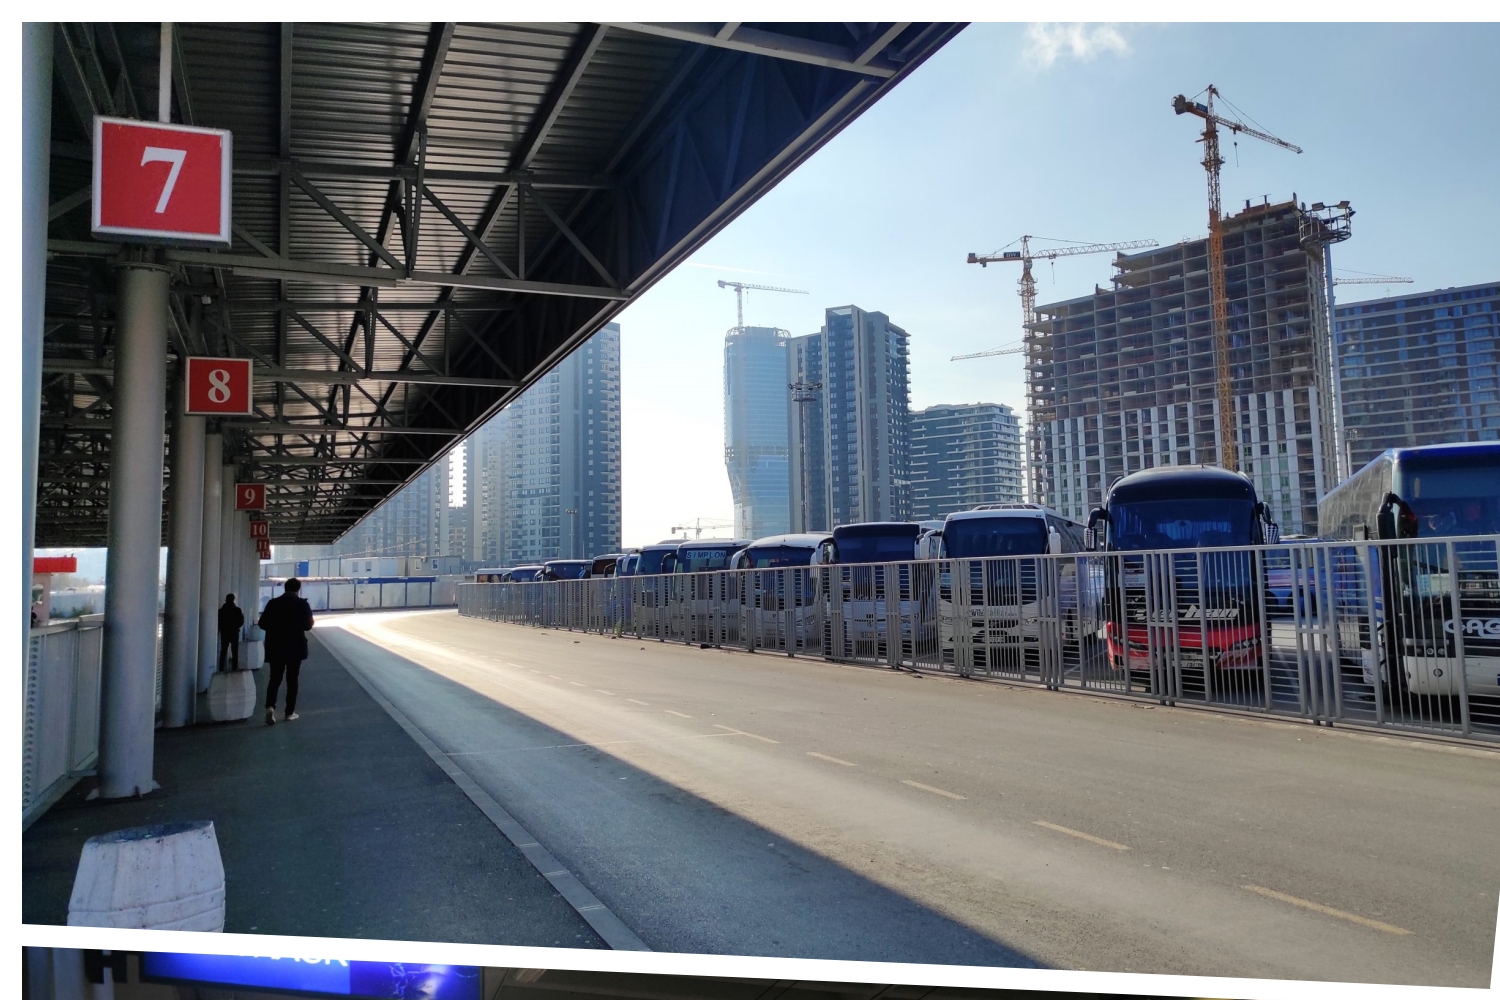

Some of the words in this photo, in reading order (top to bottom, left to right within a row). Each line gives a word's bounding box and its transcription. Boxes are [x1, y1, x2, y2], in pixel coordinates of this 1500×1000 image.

[140, 146, 187, 214] 7
[207, 368, 231, 404] 8
[244, 488, 256, 506] 9
[252, 523, 267, 536] 10
[687, 551, 726, 559] SIMPLON
